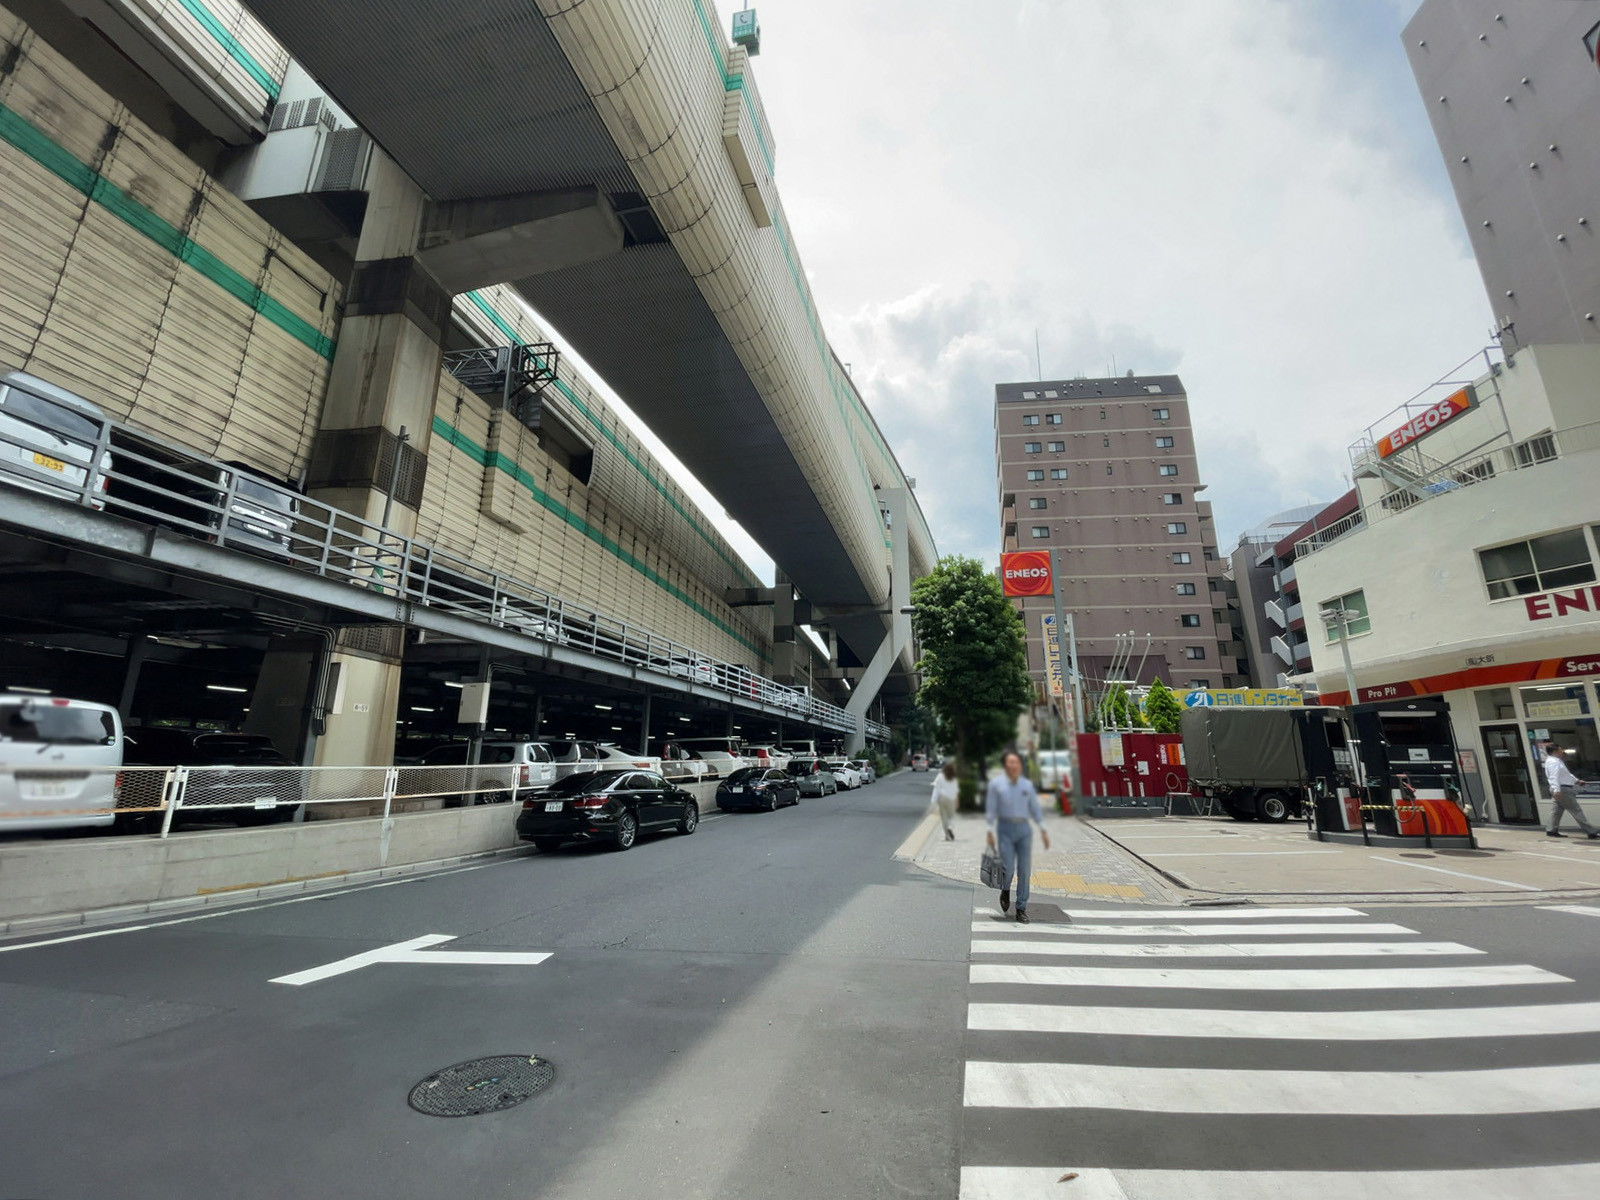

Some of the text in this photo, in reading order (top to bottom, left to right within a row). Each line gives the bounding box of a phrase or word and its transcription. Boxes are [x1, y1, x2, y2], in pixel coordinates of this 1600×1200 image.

[1389, 400, 1452, 449] ENEOS
[1005, 568, 1048, 578] ENEOS
[1367, 687, 1397, 698] Pro Pit
